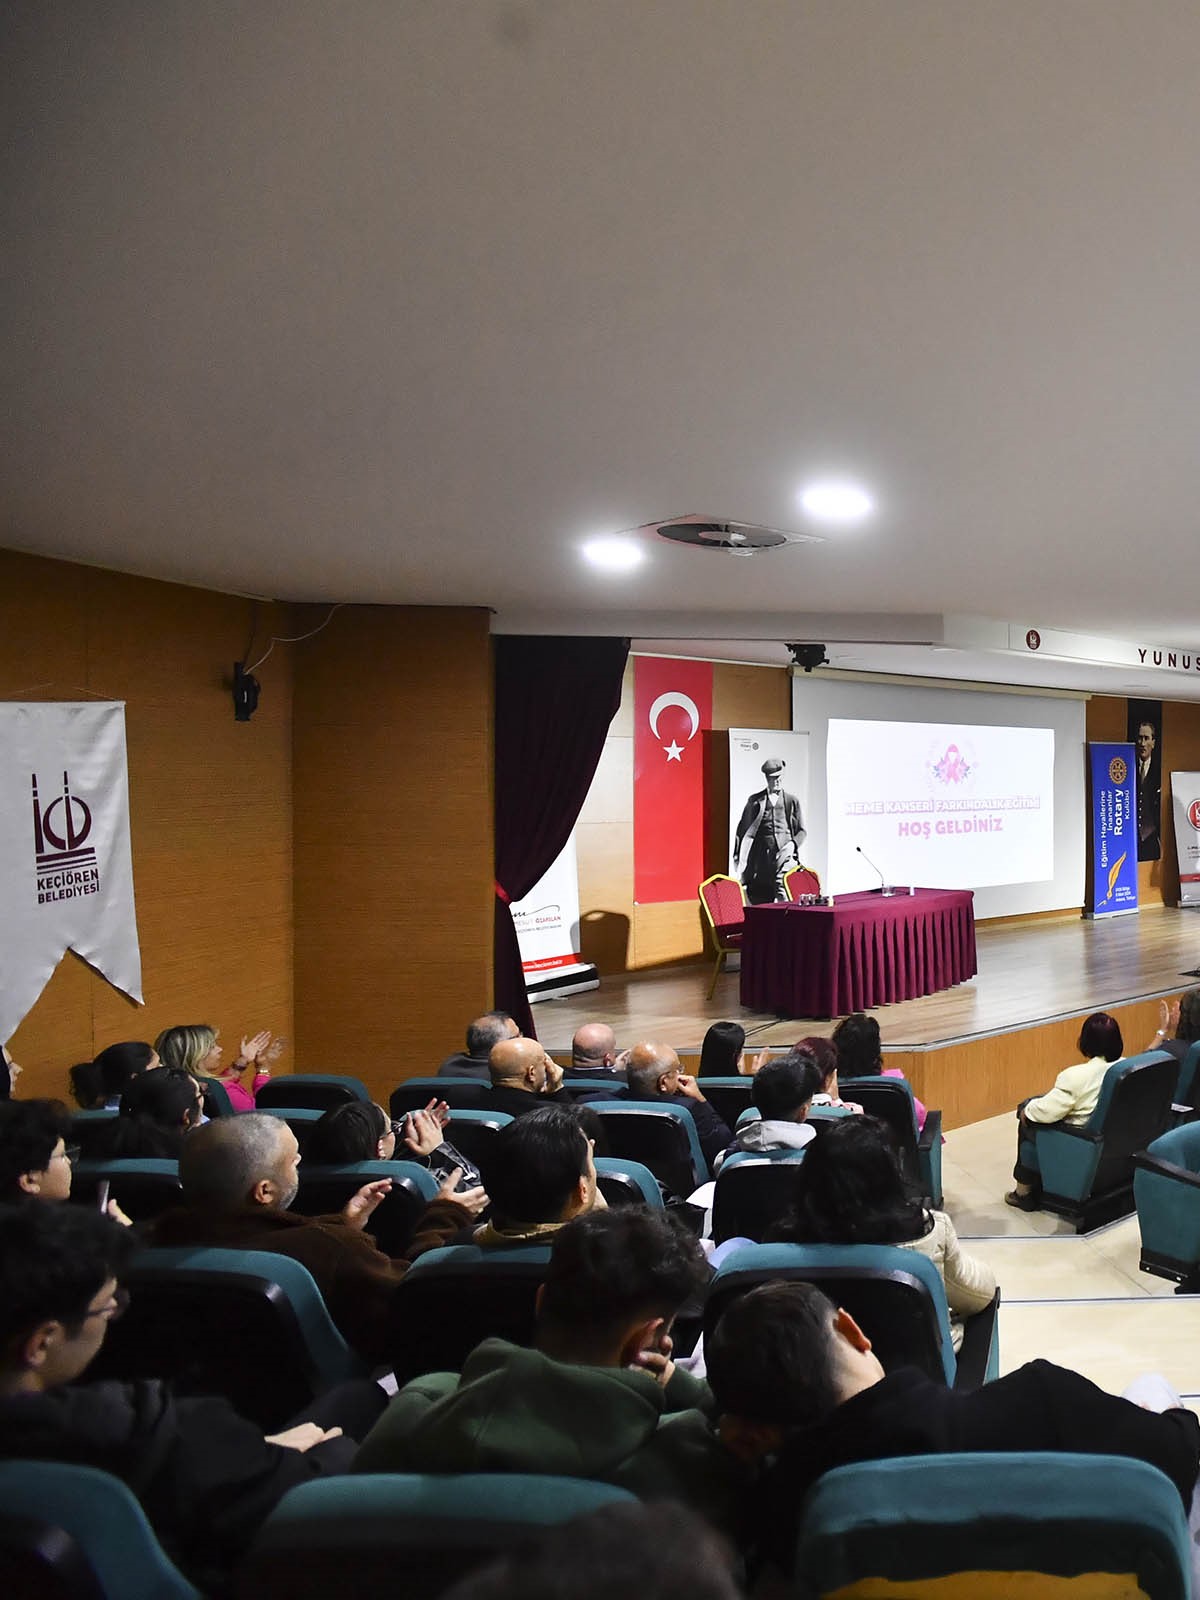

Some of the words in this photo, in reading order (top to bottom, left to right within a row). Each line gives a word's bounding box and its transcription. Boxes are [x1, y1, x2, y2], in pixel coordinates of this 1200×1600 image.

[1113, 789, 1124, 836] Rotary
[898, 821, 931, 839] HOŞ
[935, 814, 1003, 835] GELDİNİZ
[1100, 840, 1109, 868] Eğitim
[37, 868, 99, 891] KEÇİÖREN
[37, 879, 100, 904] BELEDİYESİ
